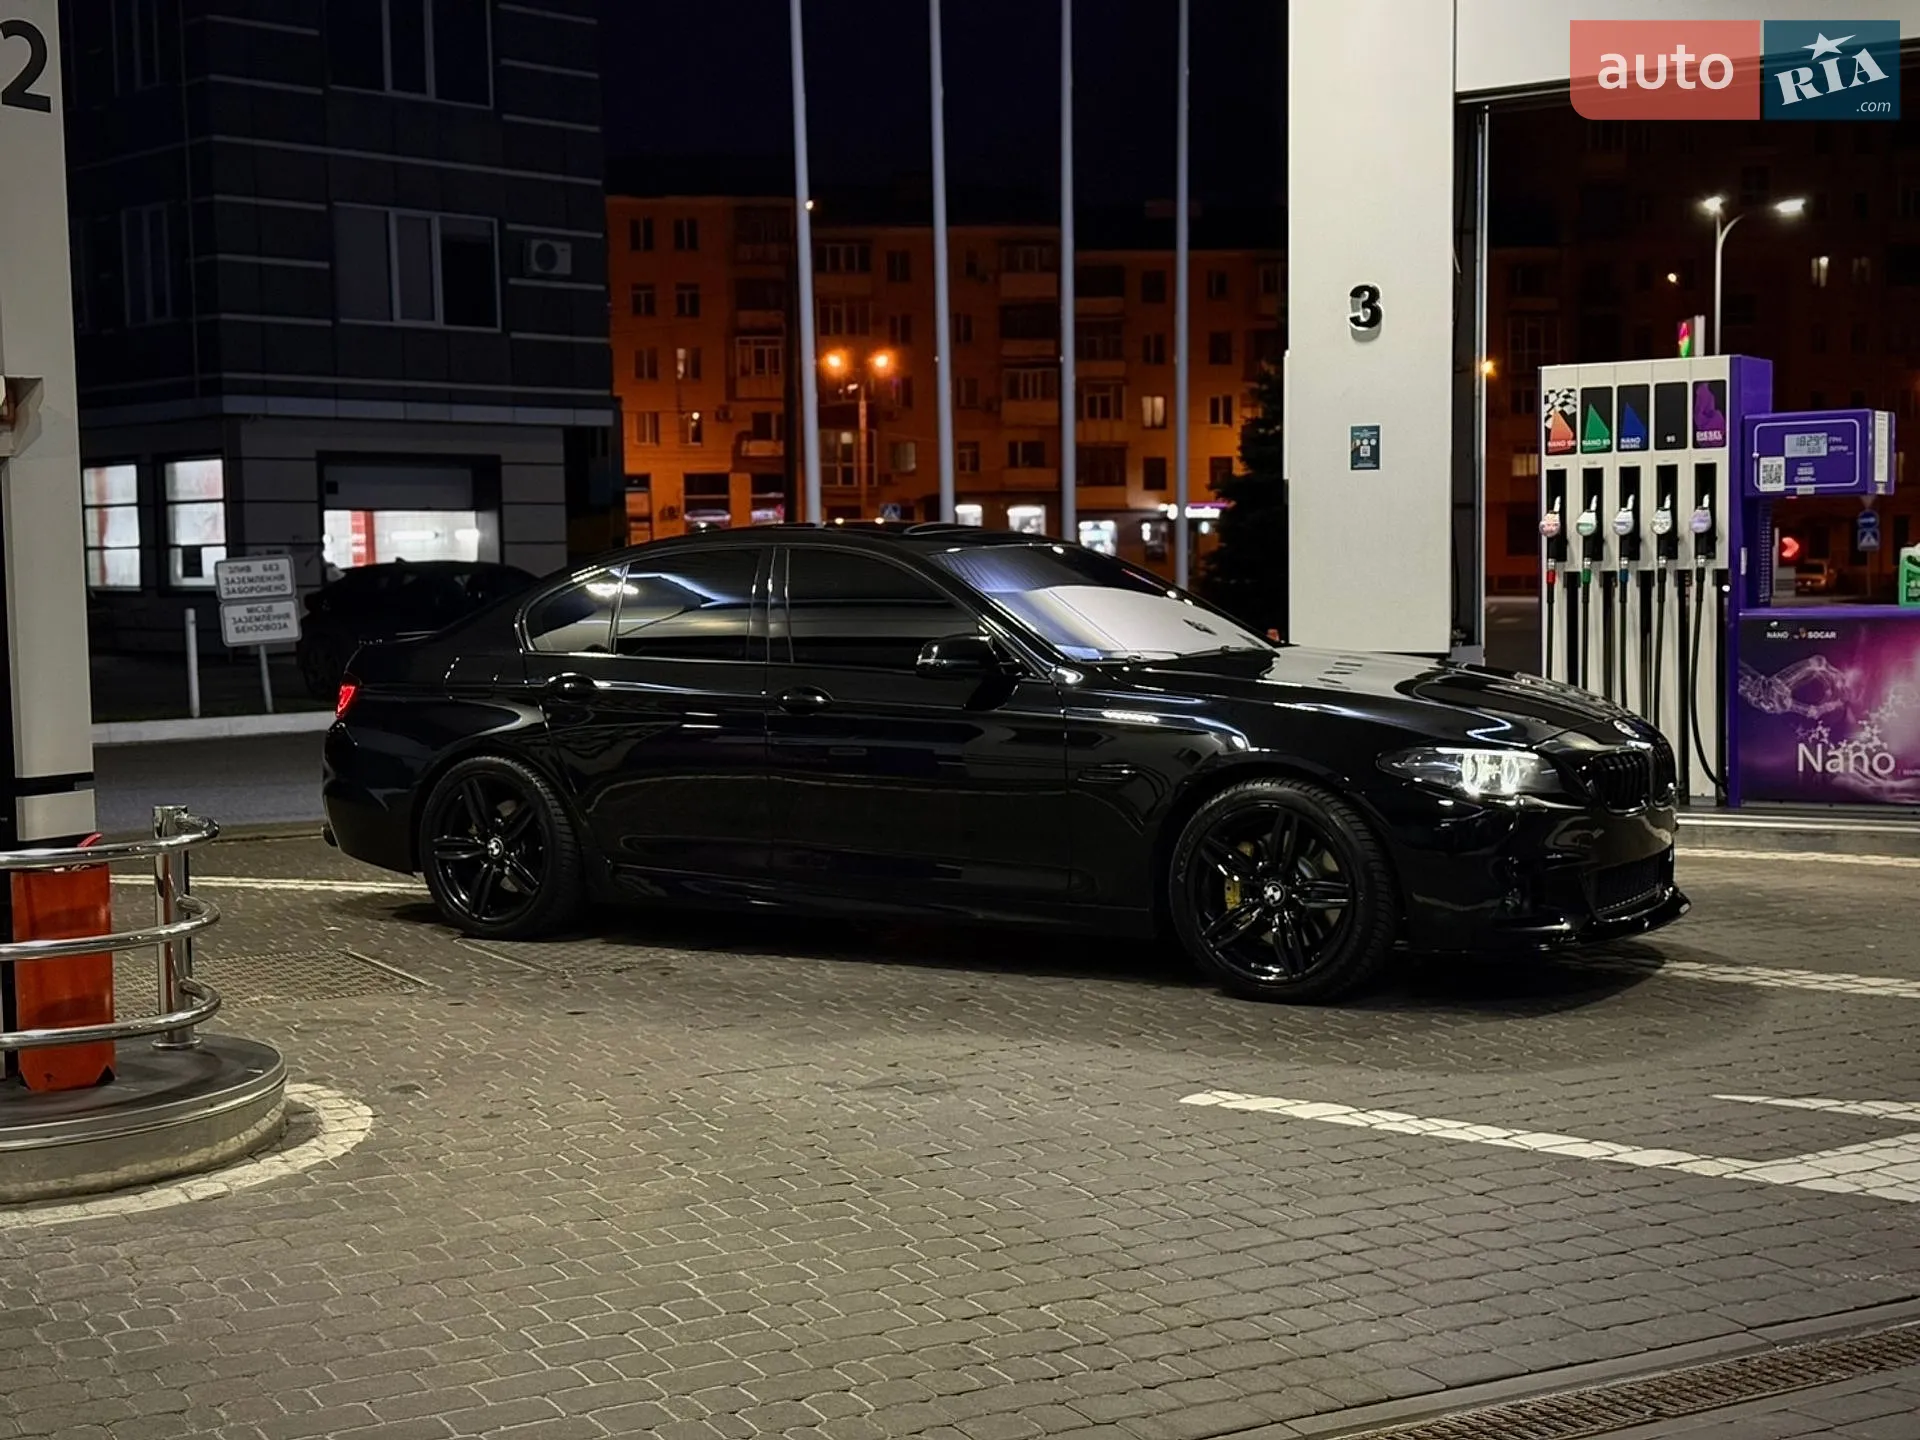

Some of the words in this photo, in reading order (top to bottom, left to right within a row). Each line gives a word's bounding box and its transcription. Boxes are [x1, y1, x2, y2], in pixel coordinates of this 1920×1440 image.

[0, 19, 51, 113] 2
[1349, 284, 1382, 328] 3
[1582, 439, 1601, 447] NANO
[262, 563, 279, 572] БЕЗ
[224, 574, 286, 586] ЗАЗЕМЛЕННЯ
[225, 583, 288, 596] ЗАБОРОНЕНО
[1766, 631, 1789, 639] NANO
[1807, 631, 1837, 639] SOCAR
[1797, 743, 1896, 774] Nano
